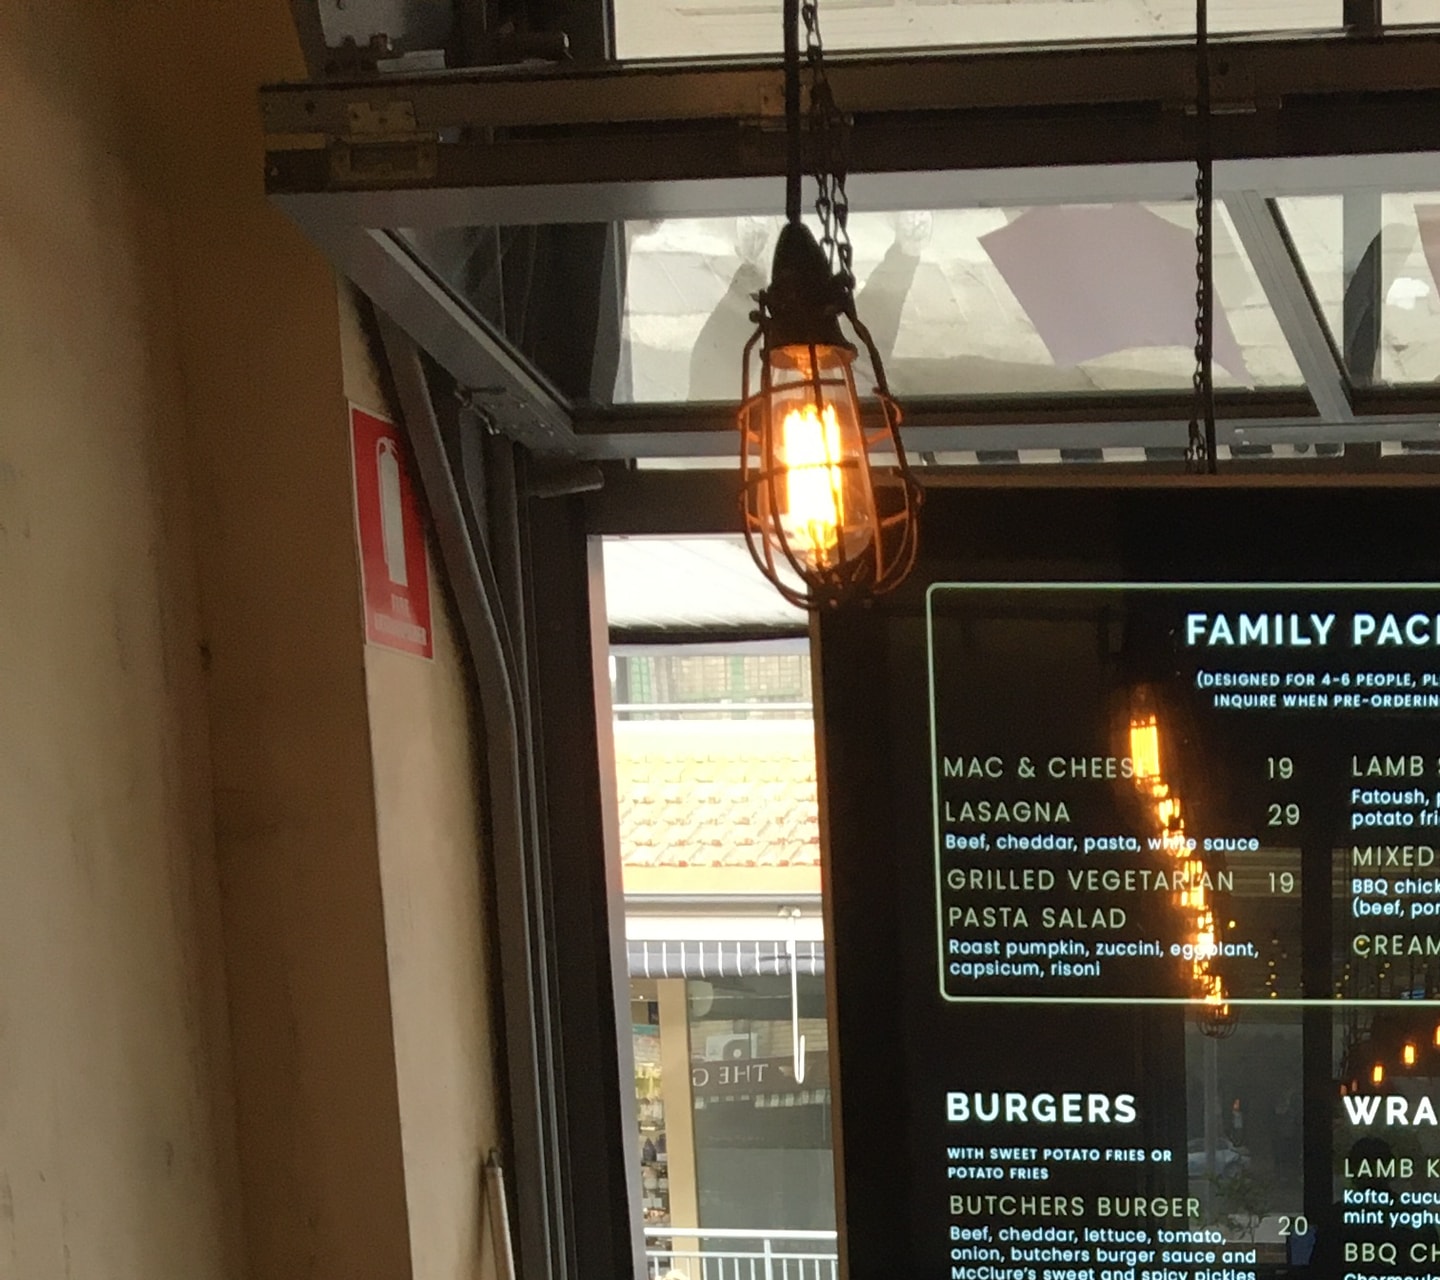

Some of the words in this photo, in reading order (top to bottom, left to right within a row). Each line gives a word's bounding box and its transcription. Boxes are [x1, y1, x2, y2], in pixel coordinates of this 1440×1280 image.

[1187, 613, 1336, 646] FAMILY
[1196, 669, 1281, 689] (DESIGNED
[1285, 673, 1316, 687] FOR
[1321, 672, 1351, 687] 4-6
[1356, 672, 1417, 688] PEOPLE,
[943, 756, 1004, 778] MAC
[1017, 756, 1036, 779] &
[1047, 756, 1150, 779] CHEES
[1267, 757, 1294, 780] 19
[1352, 755, 1424, 777] LAMB
[945, 800, 1071, 823] LASAGNA
[1268, 803, 1300, 826] 29
[1352, 845, 1435, 867] MIXED
[947, 868, 1055, 891] GRILLED
[1067, 868, 1234, 892] VEGETARIAN
[1268, 871, 1295, 894] 19
[948, 906, 1029, 928] PASTA
[1042, 907, 1127, 929] SALAD
[949, 959, 1045, 980] capsicum,
[1050, 960, 1101, 977] risoni
[946, 1091, 1137, 1124] BURGERS
[1344, 1158, 1414, 1179] LAMB
[949, 1195, 1085, 1217] BUTCHERS
[1097, 1196, 1200, 1218] BURGER
[1343, 1188, 1394, 1206] Kofta,
[950, 1225, 993, 1243] Beef,
[998, 1226, 1079, 1244] cheddar,
[1084, 1227, 1152, 1245] lettuce,
[1157, 1228, 1227, 1246] tomato,
[1277, 1215, 1308, 1237] 20
[1344, 1242, 1397, 1266] BBQ
